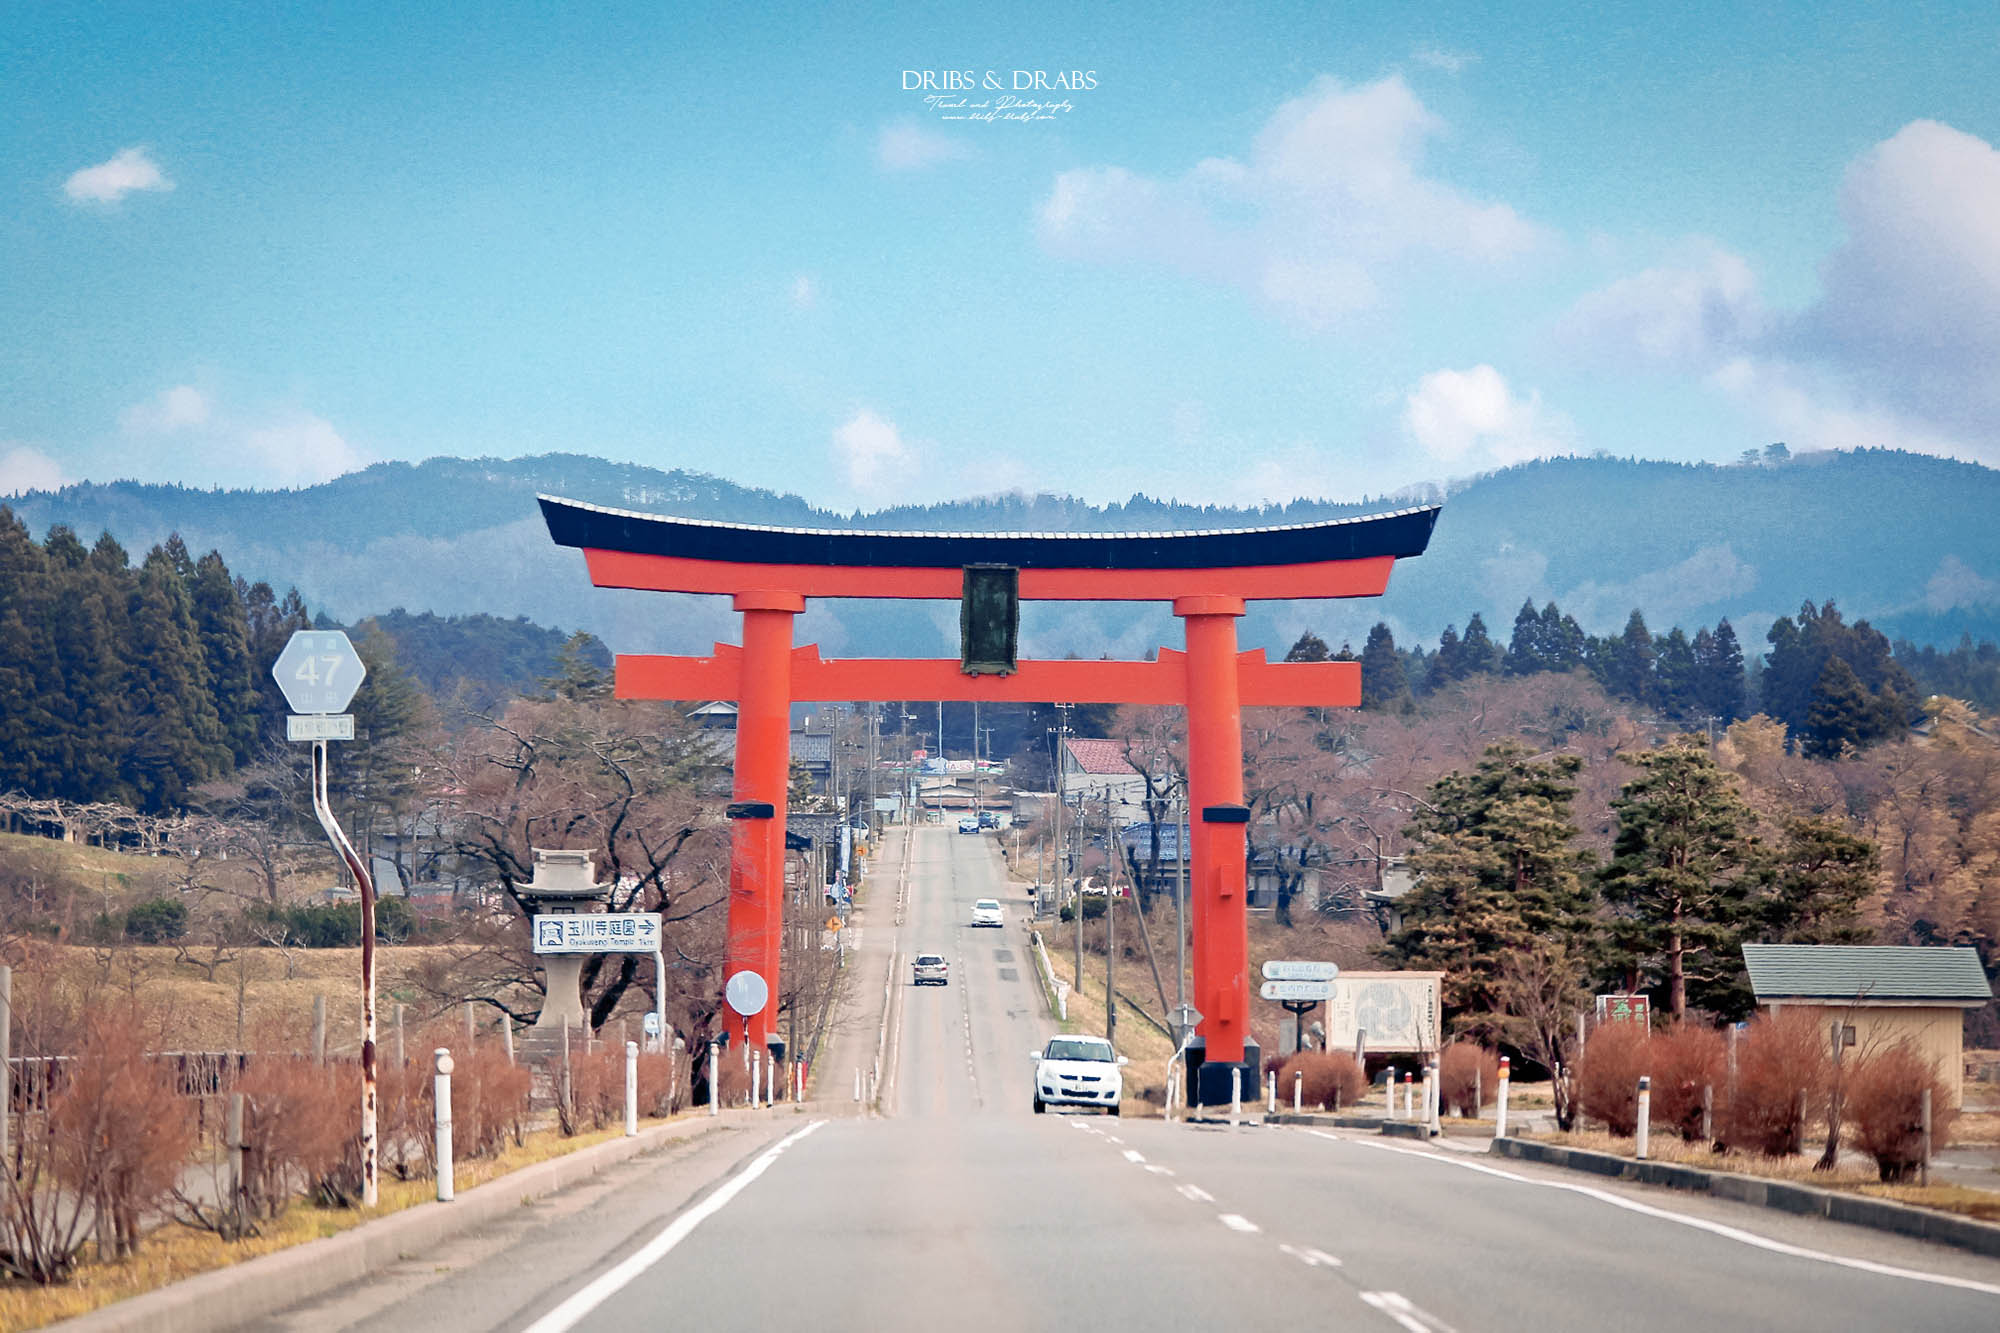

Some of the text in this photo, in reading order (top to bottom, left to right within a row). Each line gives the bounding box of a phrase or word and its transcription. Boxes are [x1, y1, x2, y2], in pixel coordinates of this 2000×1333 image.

[295, 655, 344, 687] 47
[567, 919, 636, 936] 玉川寺庭園
